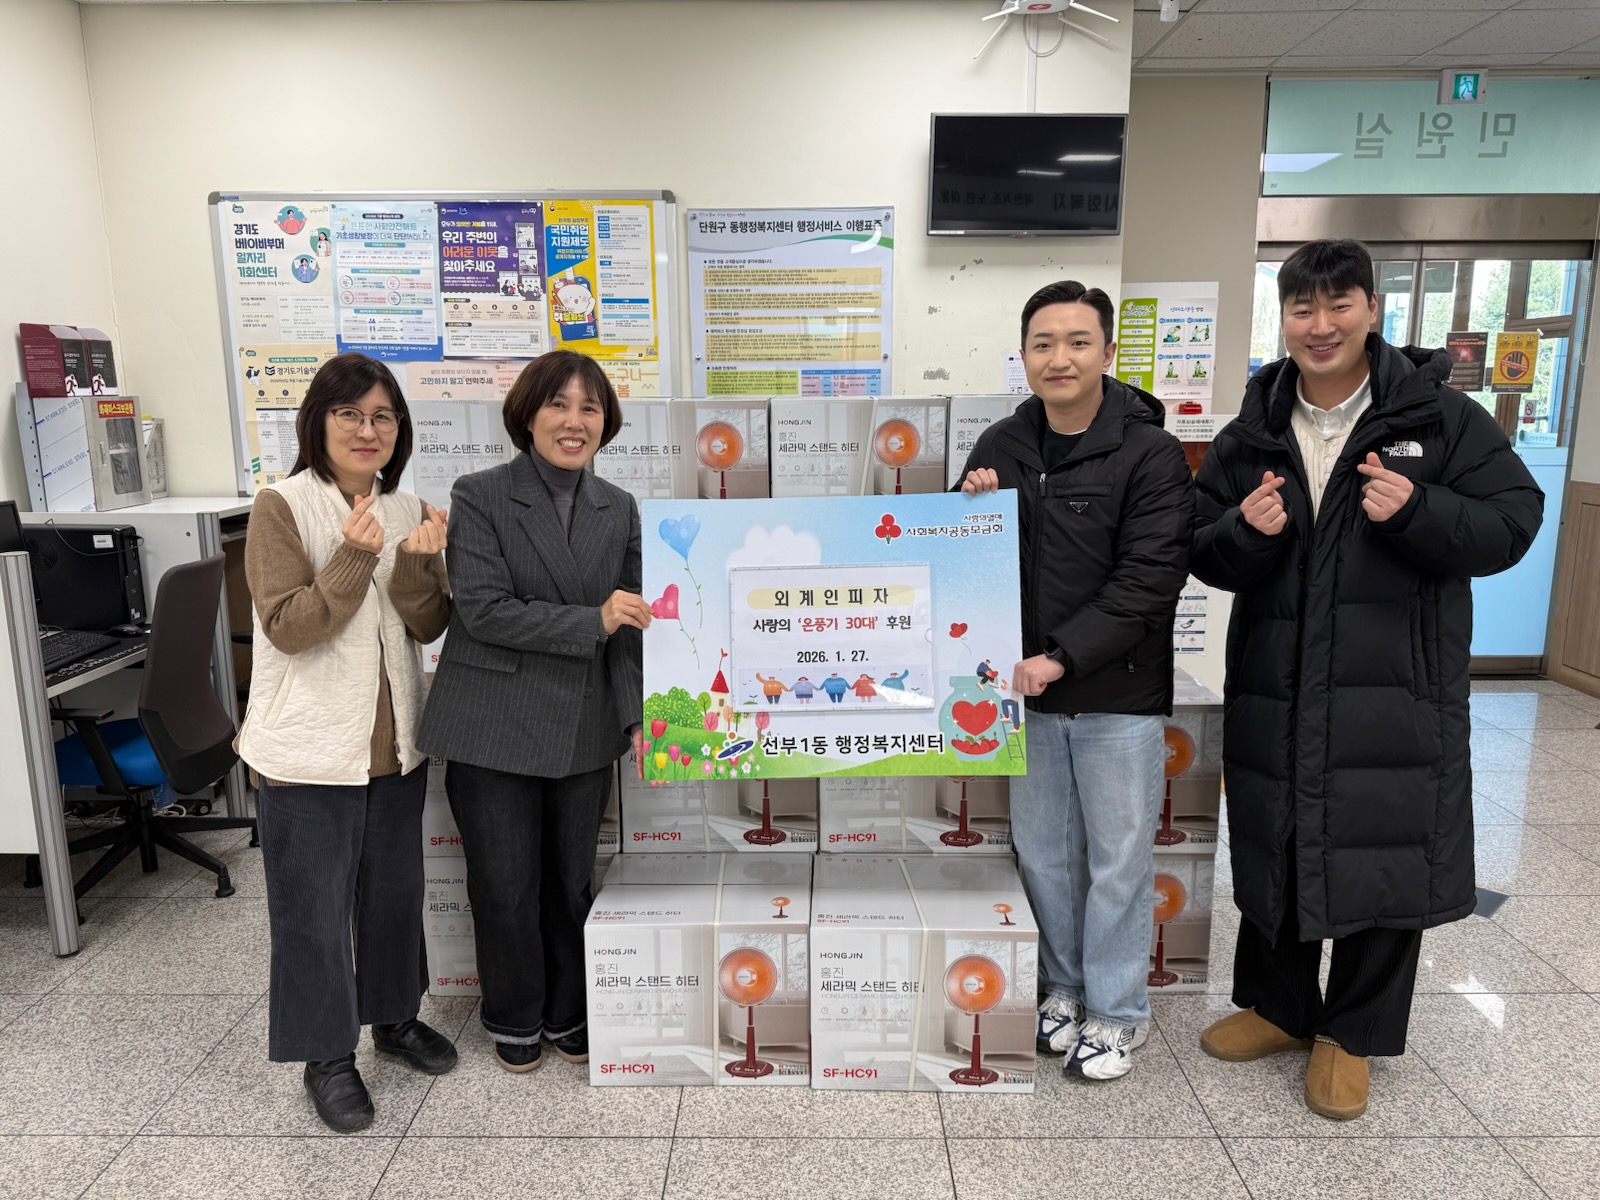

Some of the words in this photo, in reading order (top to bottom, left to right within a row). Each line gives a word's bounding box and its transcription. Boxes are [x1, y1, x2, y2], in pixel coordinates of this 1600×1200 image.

[234, 224, 259, 236] 경기도
[550, 224, 589, 235] 국민취업
[699, 221, 726, 234] 단원구
[730, 221, 793, 234] 동행정복지센터
[797, 221, 842, 234] 행정서비스
[442, 231, 463, 244] 우리
[466, 231, 498, 244] 주변의
[551, 236, 590, 247] 지원제도
[235, 238, 285, 250] 베이비부머
[443, 246, 474, 258] 어려운
[477, 246, 509, 258] 이웃을
[236, 252, 266, 264] 일자리
[443, 260, 496, 273] 찾아주세요
[237, 267, 278, 278] 기회센터
[420, 444, 449, 454] 세라믹
[452, 444, 481, 454] 스탠드
[484, 444, 504, 454] 히터
[599, 446, 627, 455] 세라믹
[631, 446, 659, 455] 스탠드
[779, 443, 806, 452] 세라믹
[810, 443, 837, 452] 스탠드
[841, 443, 859, 452] 히터
[956, 442, 975, 451] 세라
[963, 513, 1003, 523] 사랑의열매
[906, 524, 1003, 538] 사회복지공동모금회
[753, 619, 791, 633] 사랑의
[886, 616, 912, 630] 후원
[797, 651, 829, 663] 2026.
[836, 651, 845, 663] 1.
[851, 650, 869, 662] 27.
[762, 736, 828, 756] 선부1동
[835, 734, 944, 754] 행정복지센터
[430, 837, 464, 846] SF-H
[633, 832, 682, 841] SF-HC91
[828, 833, 877, 843] SF-HC91
[429, 903, 460, 912] 세라믹
[595, 963, 619, 975] 홍진
[820, 967, 844, 978] 홍진
[437, 978, 480, 986] SF-HC9
[596, 976, 631, 988] 세라믹
[636, 976, 671, 988] 스탠드
[676, 976, 699, 988] 히터
[820, 981, 856, 992] 세라믹
[861, 981, 897, 992] 스탠드
[600, 1064, 655, 1074] SF-HC91
[823, 1068, 878, 1078] SF-HC91
